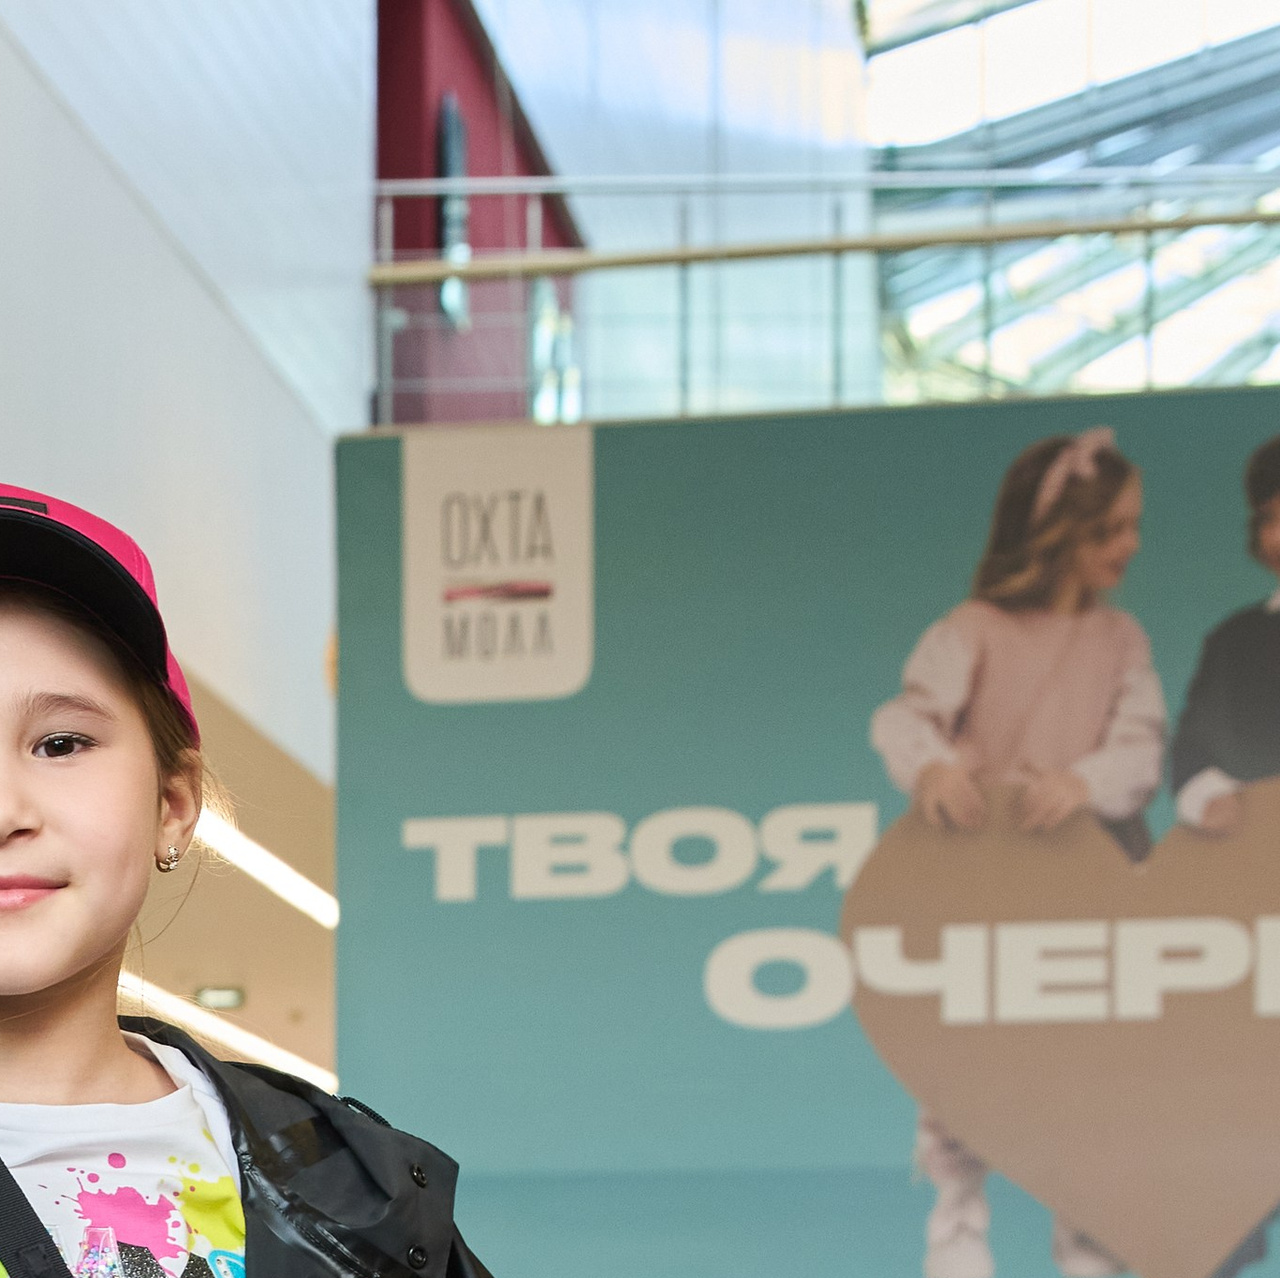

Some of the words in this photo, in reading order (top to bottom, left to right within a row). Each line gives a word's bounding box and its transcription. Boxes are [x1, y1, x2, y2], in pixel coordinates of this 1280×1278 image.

[441, 490, 554, 568] ОХТА
[402, 802, 878, 902] ТВОЯ
[704, 916, 1280, 1030] ОЧЕР
